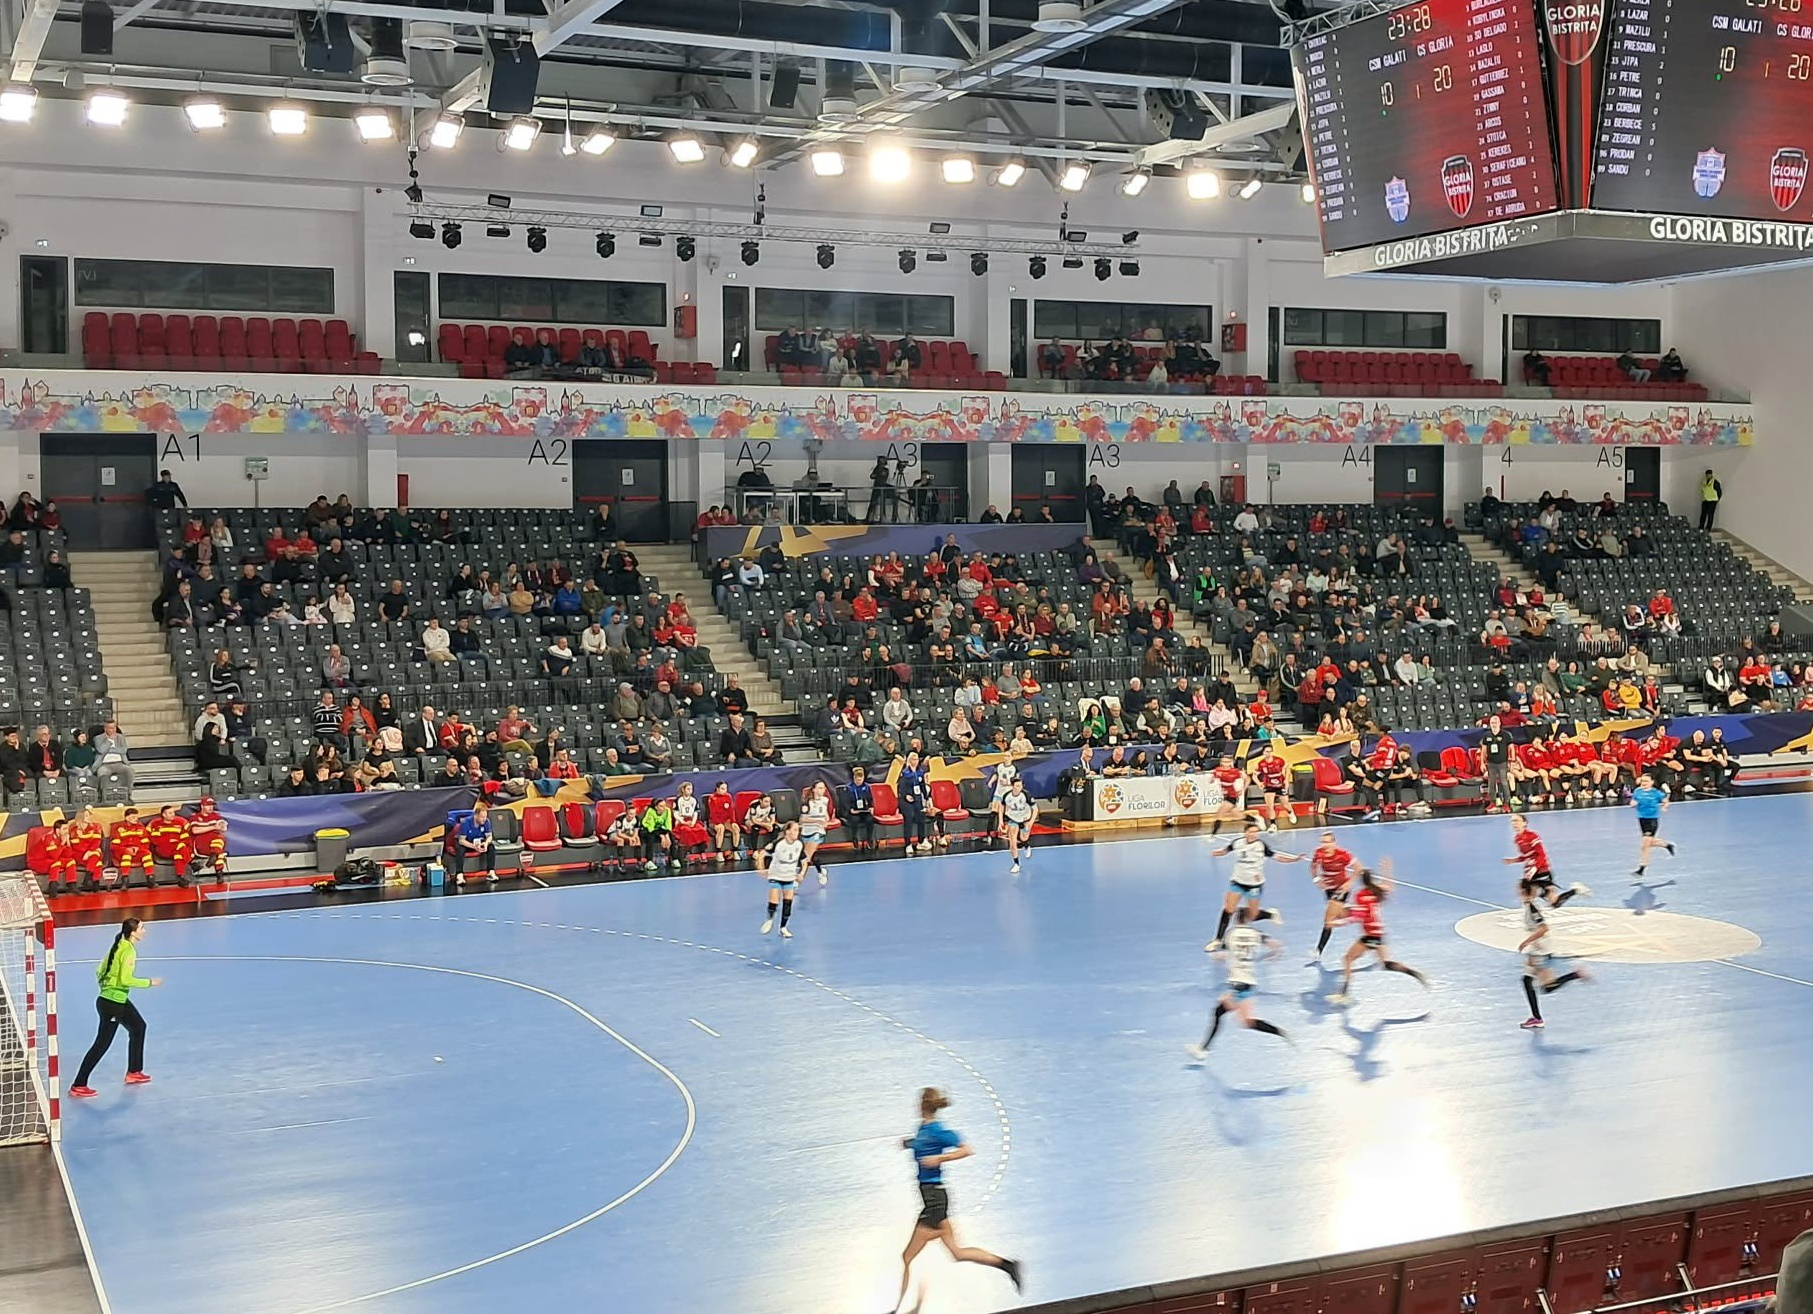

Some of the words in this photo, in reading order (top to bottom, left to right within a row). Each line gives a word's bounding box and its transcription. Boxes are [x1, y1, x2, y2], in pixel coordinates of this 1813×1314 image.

[1547, 3, 1600, 20] GLORIA
[1628, 9, 1649, 20] LAZAR
[1388, 5, 1431, 40] 23:28
[1625, 24, 1651, 36] MAZILU
[1712, 15, 1729, 30] CSM
[1732, 18, 1762, 34] GALATI
[1777, 24, 1787, 36] CS
[1417, 44, 1426, 56] CS
[1428, 36, 1454, 53] GLORIA
[1624, 40, 1656, 53] PRESCURA
[1383, 50, 1406, 67] GALATI
[1622, 56, 1638, 67] JIPA
[1660, 62, 1664, 70] 2
[1720, 46, 1736, 72] 10
[1788, 54, 1810, 80] 20
[1434, 65, 1452, 92] 20
[1620, 71, 1640, 83] PETRE
[1764, 62, 1769, 78] 1
[1522, 81, 1526, 89] 0
[1618, 87, 1642, 98] TRINCA
[1380, 82, 1394, 106] 10
[1610, 148, 1635, 160] PRODAN
[1608, 164, 1630, 175] SANDU
[1773, 165, 1803, 177] GLORIA
[1534, 186, 1538, 194] 0
[1536, 200, 1540, 208] 0
[1650, 217, 1727, 243] GLORIA
[1375, 239, 1432, 267] GLORIA
[161, 433, 200, 461] A1
[528, 439, 568, 466] A2
[736, 441, 773, 467] A2
[1088, 444, 1121, 468] A3
[1342, 445, 1372, 468] A4
[1596, 448, 1623, 468] A5
[1128, 794, 1145, 802] LIGA
